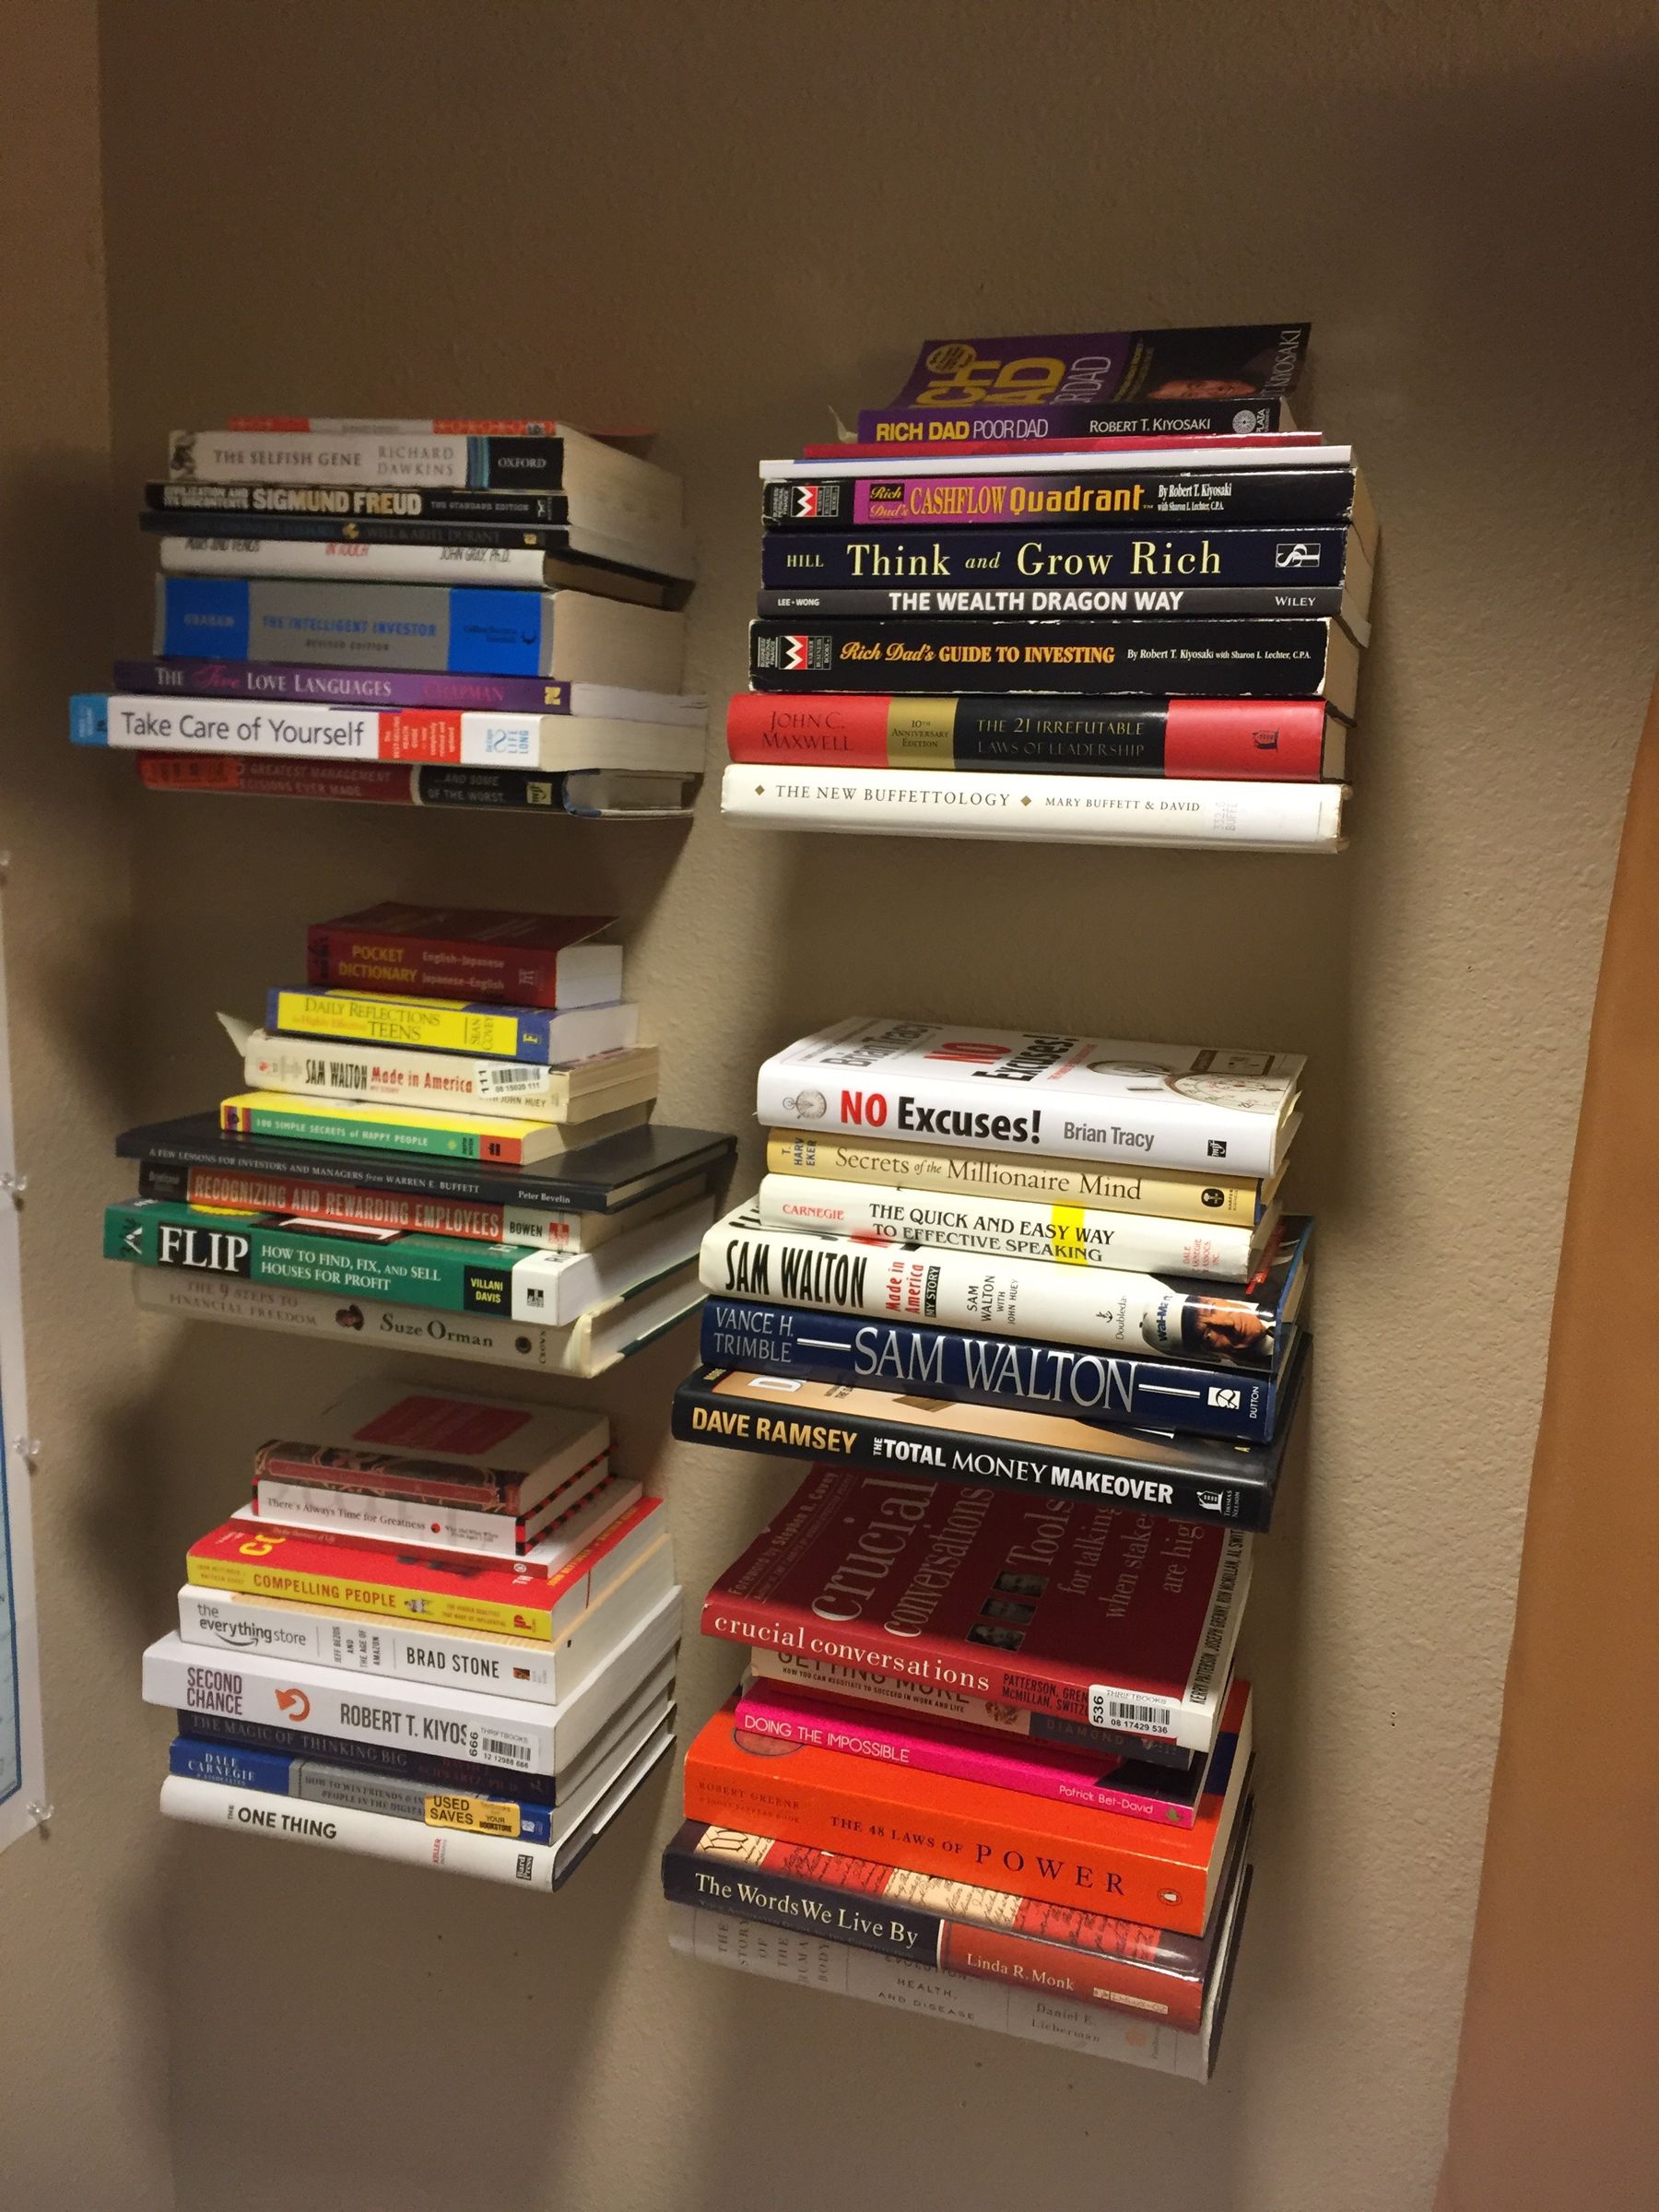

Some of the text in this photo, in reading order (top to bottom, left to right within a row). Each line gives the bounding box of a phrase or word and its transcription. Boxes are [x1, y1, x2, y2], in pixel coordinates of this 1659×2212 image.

[877, 419, 1048, 441] RICH DAD POOR DAD
[498, 458, 546, 468] OXFORD
[253, 488, 349, 512] SIGMUND
[353, 492, 421, 515] FREUD
[787, 555, 824, 568] HILL
[846, 540, 1221, 576] Think and Grow Rich
[889, 592, 1183, 611] THE WEALTH DRAGON WAY
[1276, 596, 1316, 606] WILEY
[264, 617, 436, 636] THE INTELLIGENT INVESTOR
[841, 641, 881, 661] Rich
[885, 642, 936, 662] Dad's
[939, 646, 991, 663] GUIDE
[996, 646, 1018, 663] TO
[1024, 647, 1115, 664] INVESTING
[1127, 648, 1312, 661] By Robert T. Kiyosaki with Sharon L. Lechter, C.P.A.
[121, 712, 171, 736] Take
[179, 715, 229, 739] Care
[237, 717, 261, 741] of
[268, 720, 364, 746] Yourself
[977, 718, 1144, 736] THE 21 IRREFUTABLE
[507, 729, 517, 754] LIFE
[519, 729, 529, 755] LONG
[978, 741, 1144, 758] LAWS OF LEADERSHIP
[776, 785, 1011, 806] THE NEW BUFFETTOLOGY
[1045, 797, 1200, 812] MARY BUFFETT & DAVID
[368, 1020, 421, 1041] TEENS
[469, 1019, 481, 1045] SEAN
[482, 1017, 494, 1050] COVEY
[841, 1089, 1041, 1144] NO Excuses!
[256, 1118, 429, 1147] 100 SIMPLE SECRETS of HAPPY PEOPLE
[1064, 1122, 1155, 1152] Brian Tracy
[835, 1146, 1142, 1200] Secrets of the Millionaire Mind
[518, 1190, 571, 1205] Peter Bevelin
[782, 1204, 844, 1220] CARNEGIE
[869, 1203, 1115, 1244] THE QUICK AND EASY WAY
[510, 1221, 543, 1237] BOWEN
[159, 1225, 249, 1273] FLIP
[873, 1223, 1102, 1263] TO EFFECTIVE SPEAKING
[261, 1263, 391, 1289] HOUSES FOR PROFIT
[725, 1240, 867, 1309] SAM WALTON
[905, 1265, 924, 1314] America
[967, 1286, 978, 1312] SAM
[982, 1275, 995, 1322] WALTON
[380, 1313, 494, 1347] Suze Orman
[715, 1307, 794, 1337] VANCE H.
[714, 1333, 792, 1363] TRIMBLE
[855, 1326, 1137, 1413] SAM WALTON
[1250, 1385, 1259, 1418] DUTTON
[692, 1407, 857, 1454] DAVE RAMSEY
[883, 1439, 1173, 1504] TOTAL MONEY MAKEOVER
[1223, 1489, 1232, 1517] THOMAS
[1232, 1491, 1241, 1518] NELSON
[253, 1574, 395, 1607] COMPELLING PEOPLE
[406, 1646, 500, 1679] BRAD STONE
[714, 1615, 990, 1691] crucial conversations
[187, 1667, 242, 1694] SECOND
[187, 1688, 243, 1715] CHANCE
[1093, 1696, 1104, 1724] 536
[1106, 1689, 1167, 1704] THRIFTBOOKS
[481, 1727, 528, 1743] THRIFTBOOKS
[745, 1715, 910, 1764] DOING THE IMPOSSIBLE
[1111, 1719, 1168, 1734] 08 17429 536
[433, 1794, 469, 1811] USED
[699, 1782, 800, 1809] ROBERT GREENE
[238, 1807, 337, 1840] ONE THING
[429, 1807, 474, 1825] SAVES
[831, 1816, 1125, 1896] THE 48 LAWS OF POWER
[695, 1873, 918, 1949] The Words We Live By
[967, 1954, 1077, 1991] Linda R. Monk
[897, 1978, 958, 2001] HEALTH,
[878, 1991, 975, 2021] AND DISEASE
